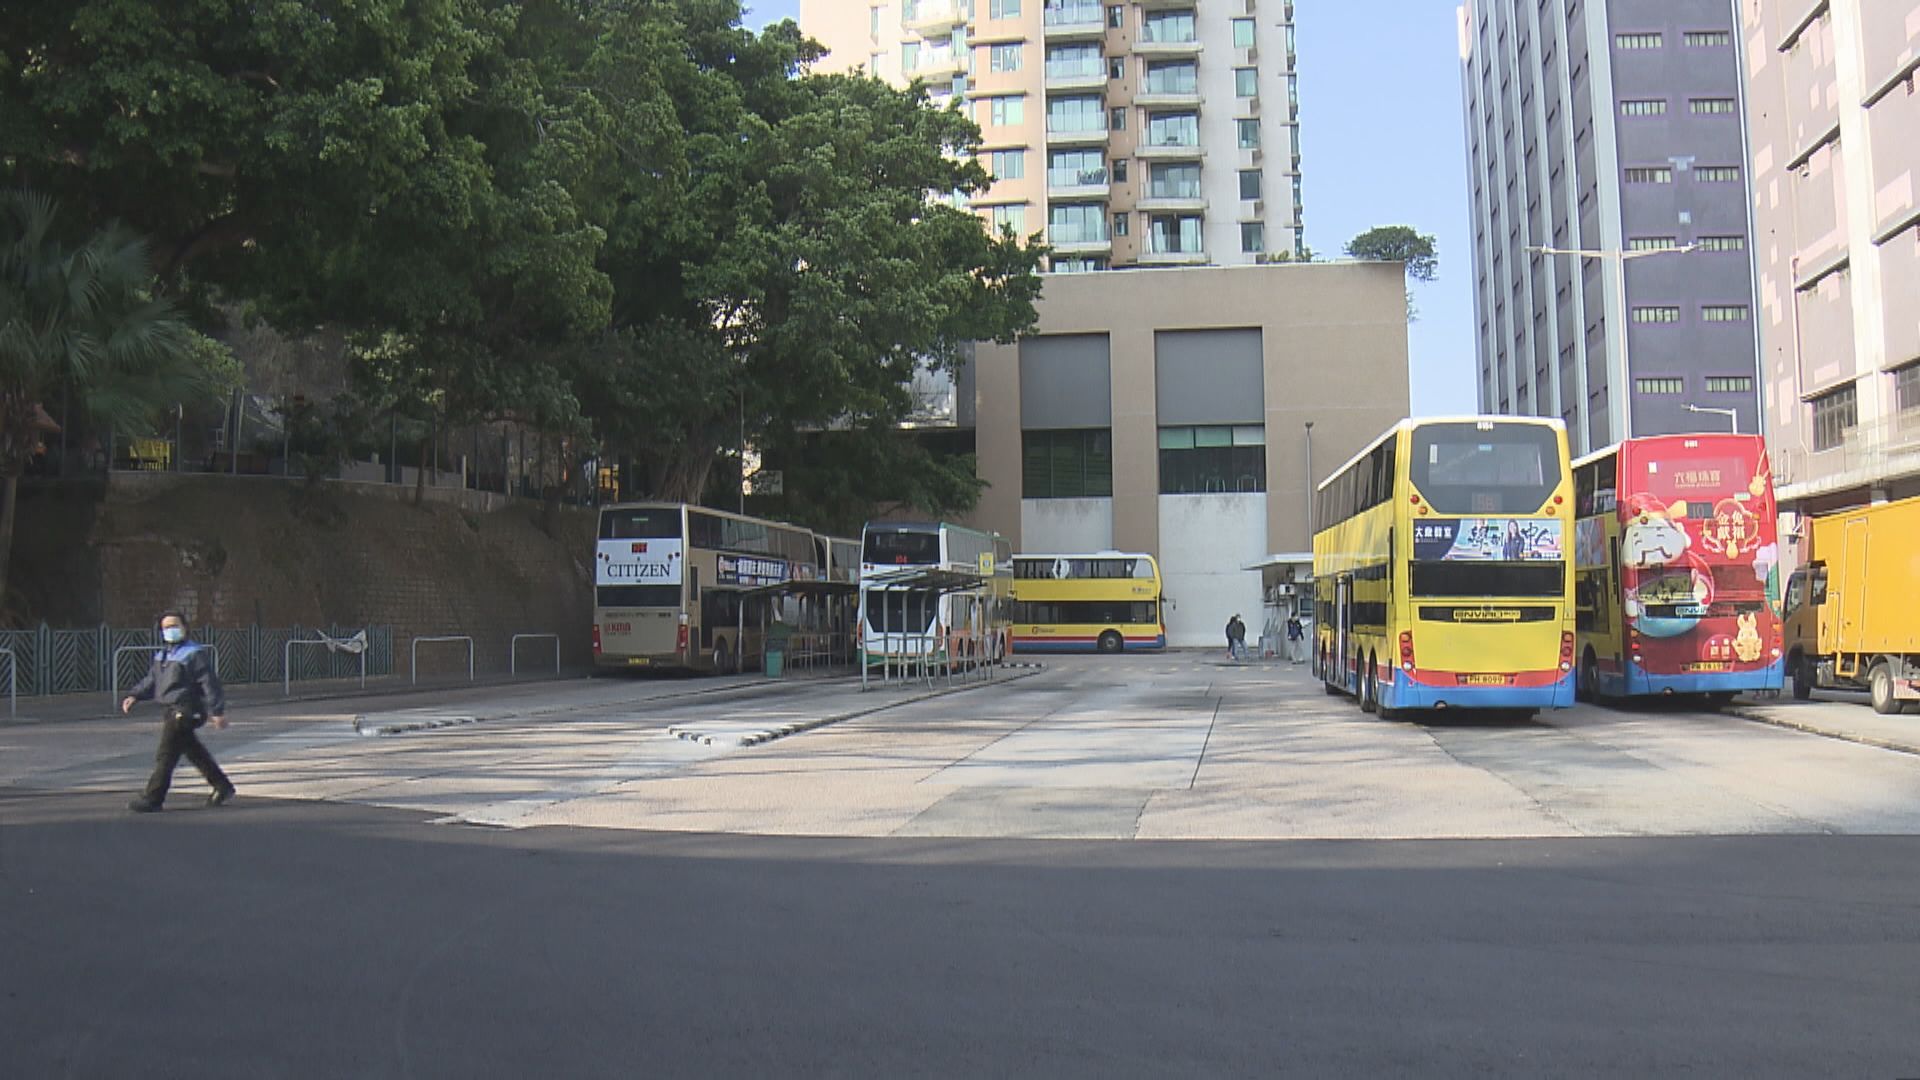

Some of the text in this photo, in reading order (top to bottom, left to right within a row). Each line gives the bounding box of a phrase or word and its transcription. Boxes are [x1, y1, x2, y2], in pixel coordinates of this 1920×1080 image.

[1675, 470, 1720, 483] 六福珠寶
[1691, 504, 1705, 518] 10
[607, 564, 670, 577] CITIZEN
